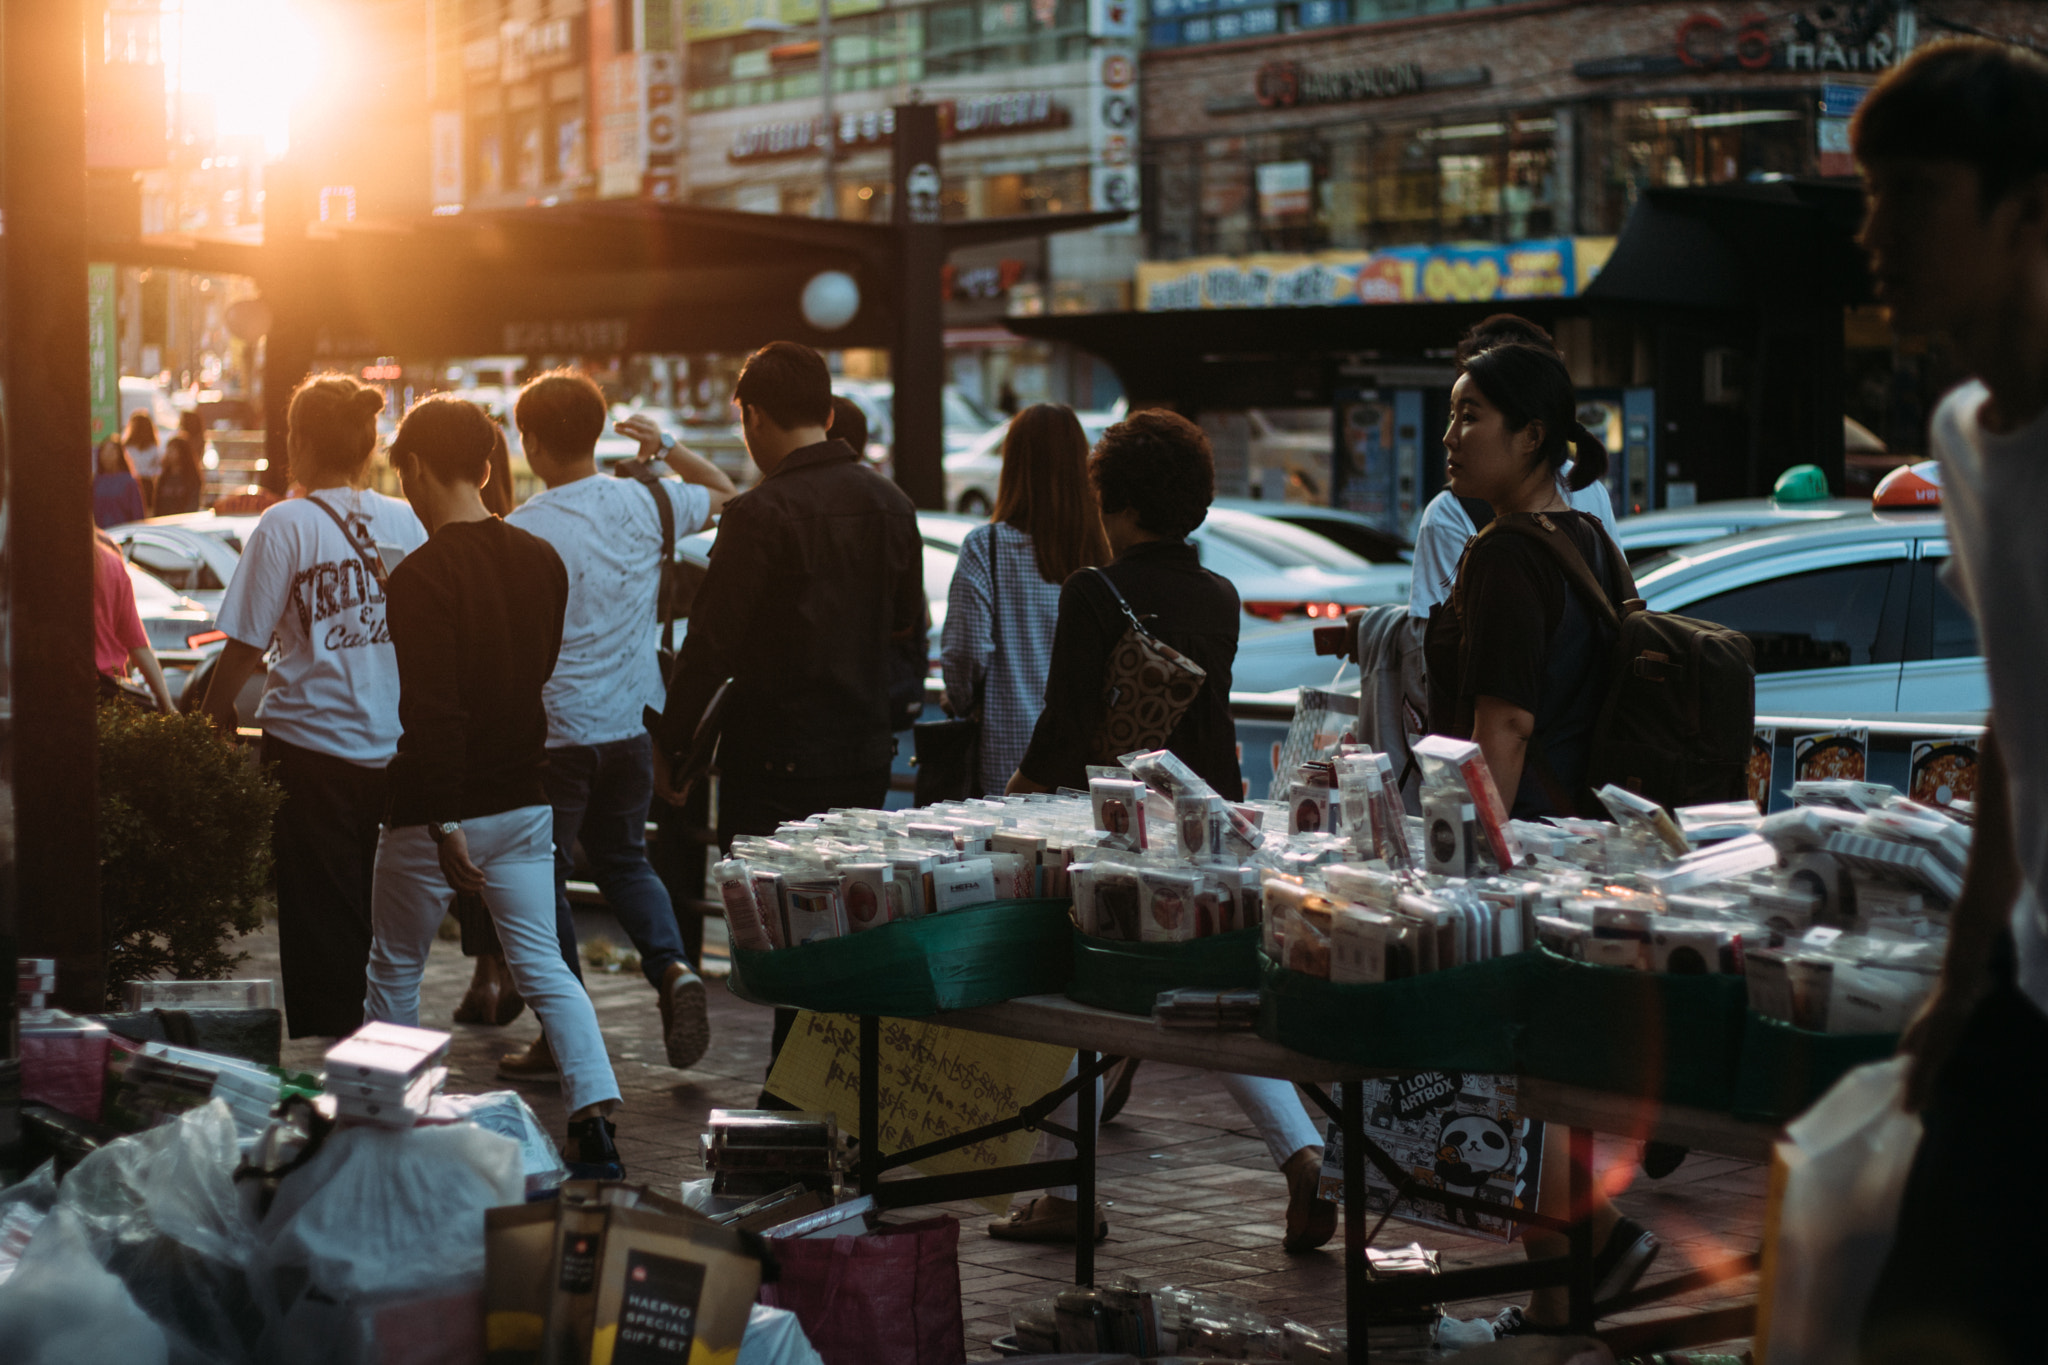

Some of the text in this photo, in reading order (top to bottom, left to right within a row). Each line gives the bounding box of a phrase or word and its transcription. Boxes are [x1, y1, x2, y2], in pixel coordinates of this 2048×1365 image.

[1399, 1083, 1407, 1096] I
[1407, 1071, 1445, 1092] LOVE
[1401, 1078, 1454, 1112] ARTBOX
[628, 1295, 691, 1319] HAEPYO
[625, 1311, 688, 1336] SPECIAL
[621, 1329, 688, 1352] GIFT SET
